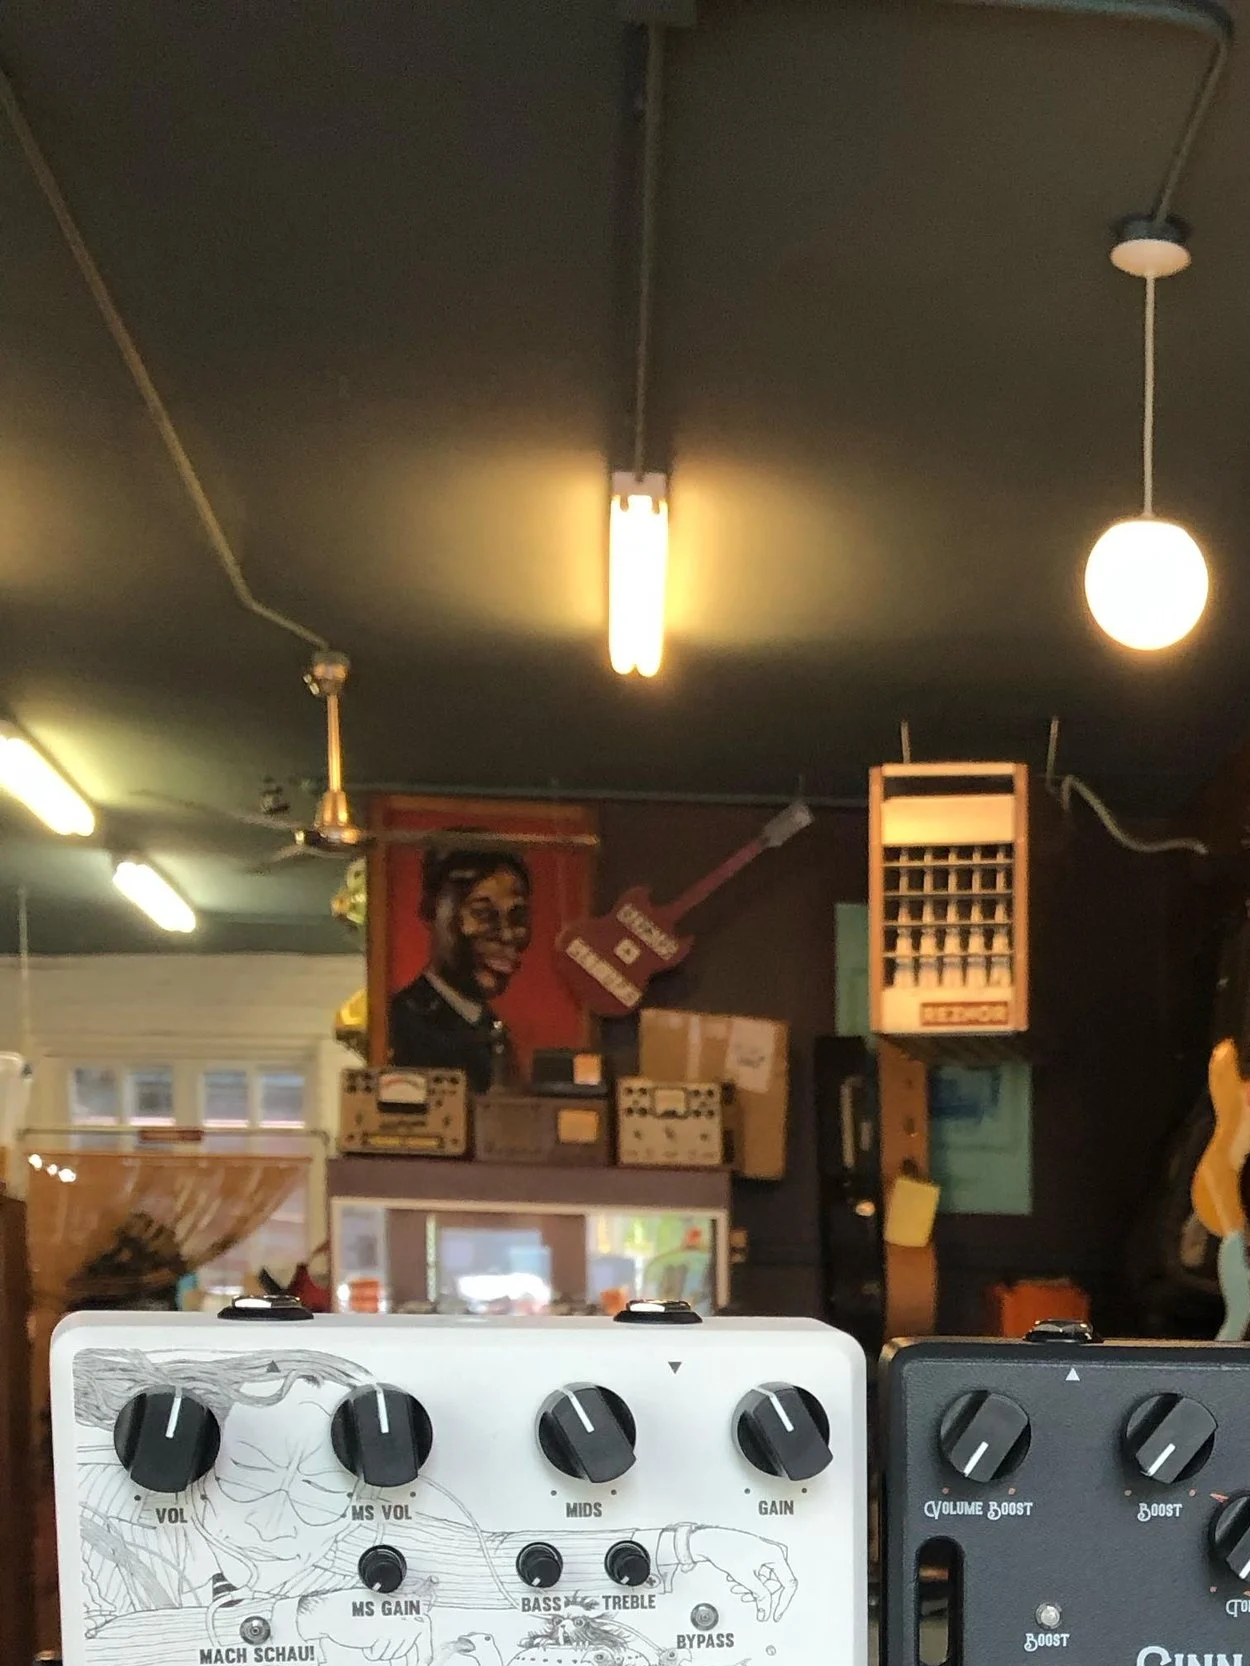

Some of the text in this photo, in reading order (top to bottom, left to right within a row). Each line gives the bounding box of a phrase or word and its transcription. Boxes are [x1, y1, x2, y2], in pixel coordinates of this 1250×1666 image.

[156, 1507, 188, 1524] VOL
[352, 1504, 412, 1521] MS VOL
[566, 1502, 602, 1518] MIDS
[758, 1500, 794, 1516] GAIN
[352, 1600, 421, 1617] MS GAIN
[521, 1596, 562, 1613] BASS
[602, 1594, 656, 1610] TREBLE
[676, 1633, 734, 1649] BYPASS
[199, 1646, 315, 1664] MACH SCHAU!
